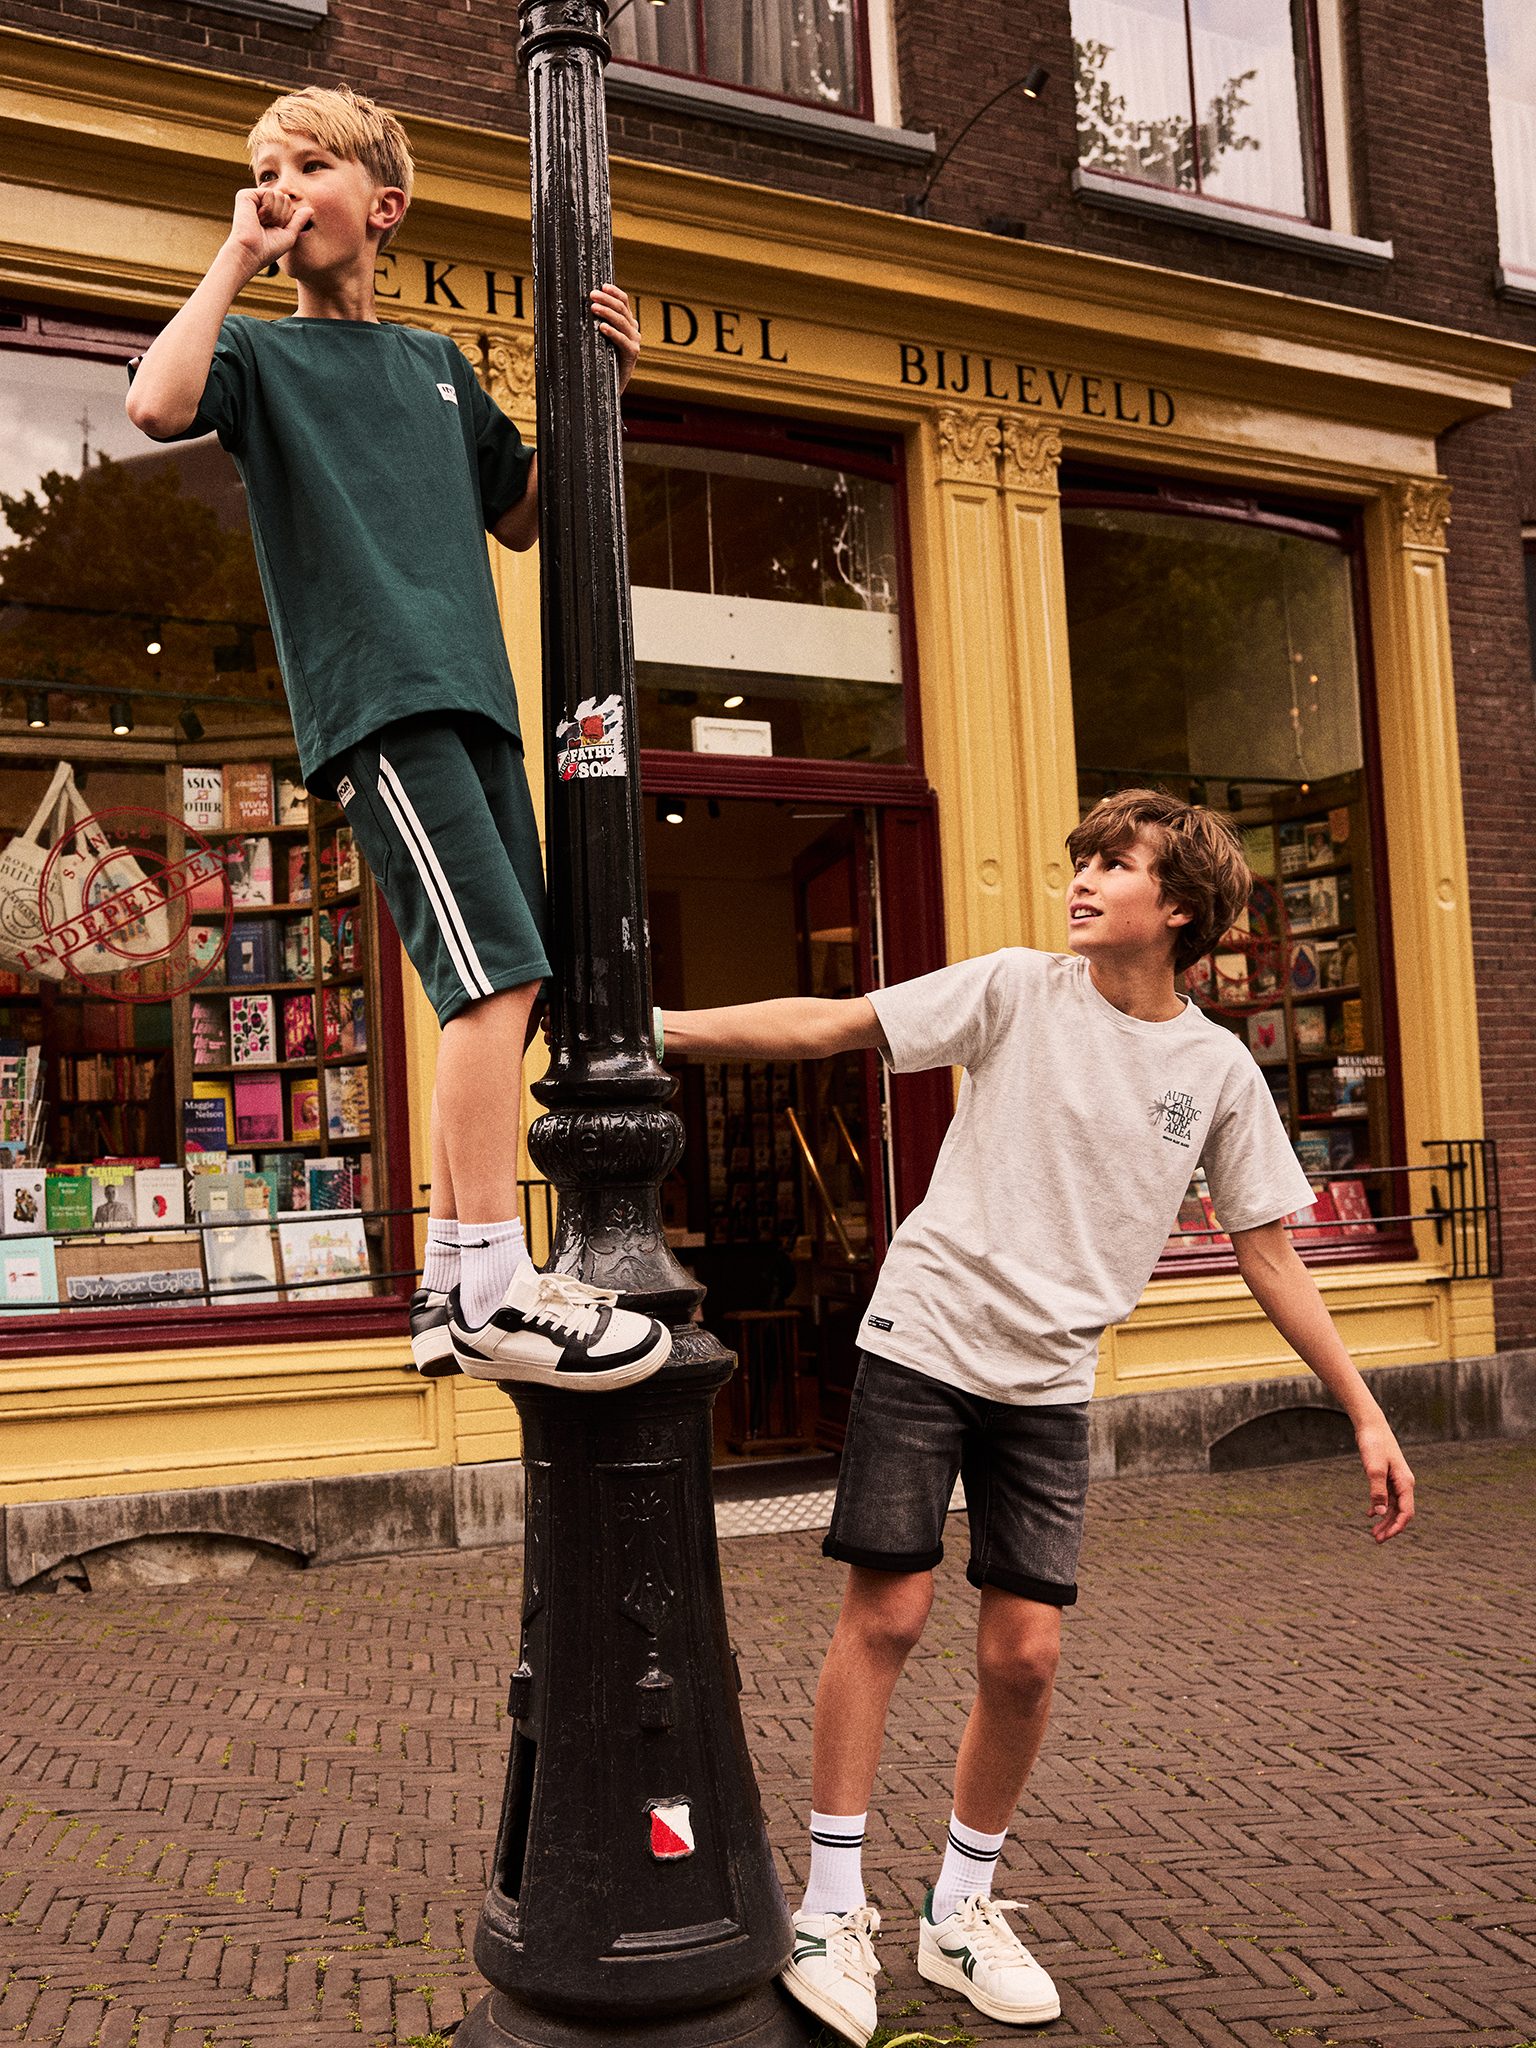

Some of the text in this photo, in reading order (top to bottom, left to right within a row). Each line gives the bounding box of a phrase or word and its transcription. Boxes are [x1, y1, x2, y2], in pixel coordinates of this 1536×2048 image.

[900, 343, 1176, 428] BIJLEVELD
[570, 746, 614, 762] FATHE
[187, 777, 222, 789] ASIAN
[185, 802, 222, 813] OTHER
[239, 801, 268, 809] SYLVIA
[242, 809, 269, 817] PLATH
[16, 835, 249, 973] INDEPENDENT
[154, 953, 199, 983] 1865
[184, 1101, 215, 1111] Maggie
[1164, 1090, 1193, 1106] AUTH
[195, 1110, 224, 1119] Nelson
[1165, 1110, 1192, 1129] SURF
[1172, 1102, 1202, 1121] ENTIC
[1164, 1122, 1191, 1140] AREA
[73, 1273, 201, 1300] Buy your English
